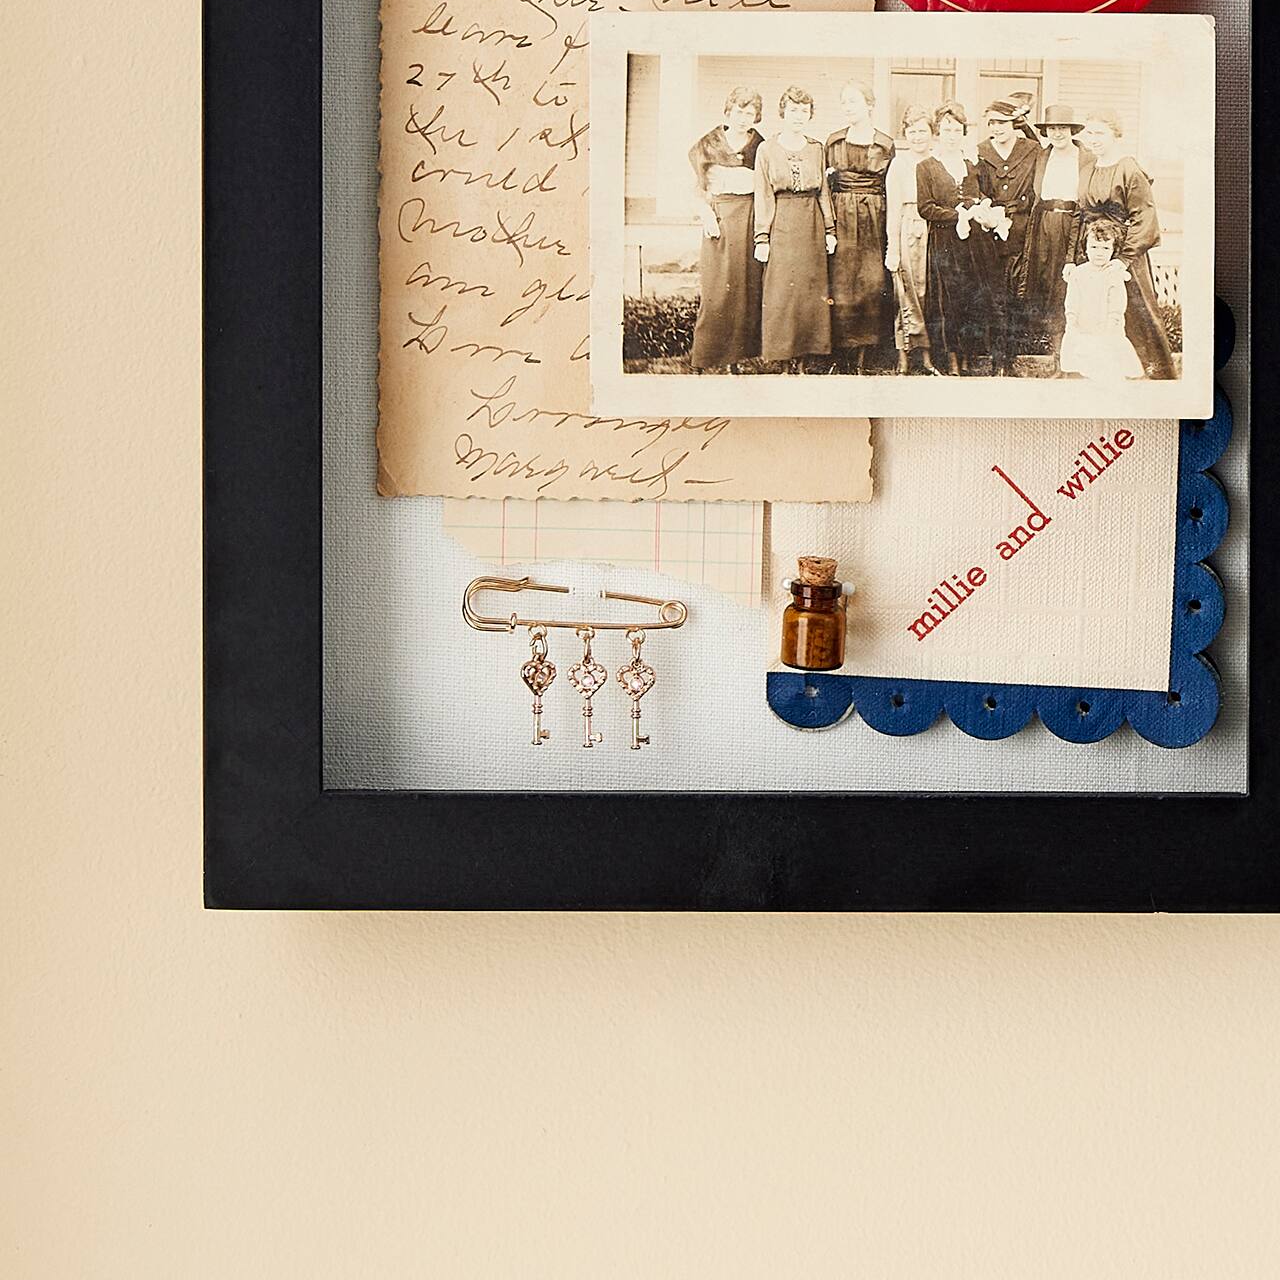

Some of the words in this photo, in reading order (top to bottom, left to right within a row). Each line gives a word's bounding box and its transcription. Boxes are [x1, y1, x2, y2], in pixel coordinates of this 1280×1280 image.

[411, 1, 533, 48] leave
[404, 103, 478, 156] the
[411, 160, 558, 194] could
[906, 564, 989, 642] millie
[991, 465, 1053, 562] and
[1055, 426, 1135, 501] willie
